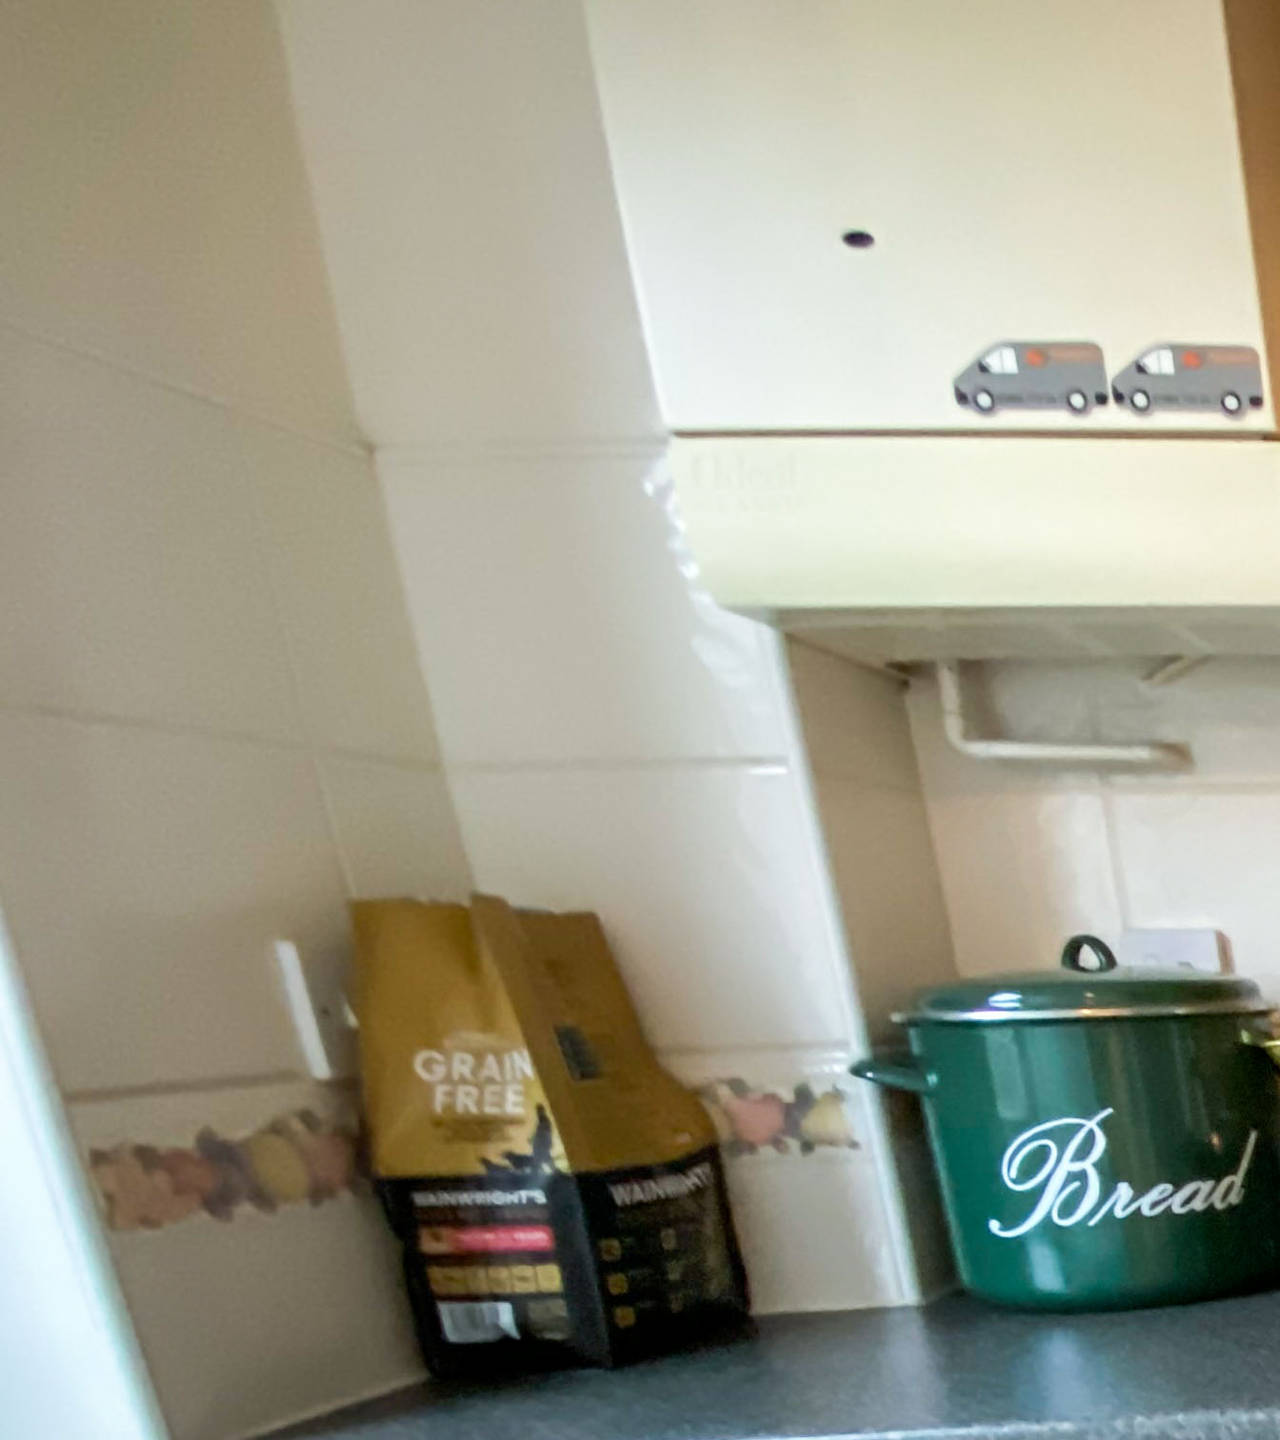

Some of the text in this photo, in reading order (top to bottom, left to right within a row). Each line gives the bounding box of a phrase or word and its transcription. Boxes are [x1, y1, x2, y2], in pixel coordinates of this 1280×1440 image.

[413, 1047, 535, 1082] GRAIN
[433, 1083, 526, 1115] FREE
[988, 1107, 1258, 1238] Bread
